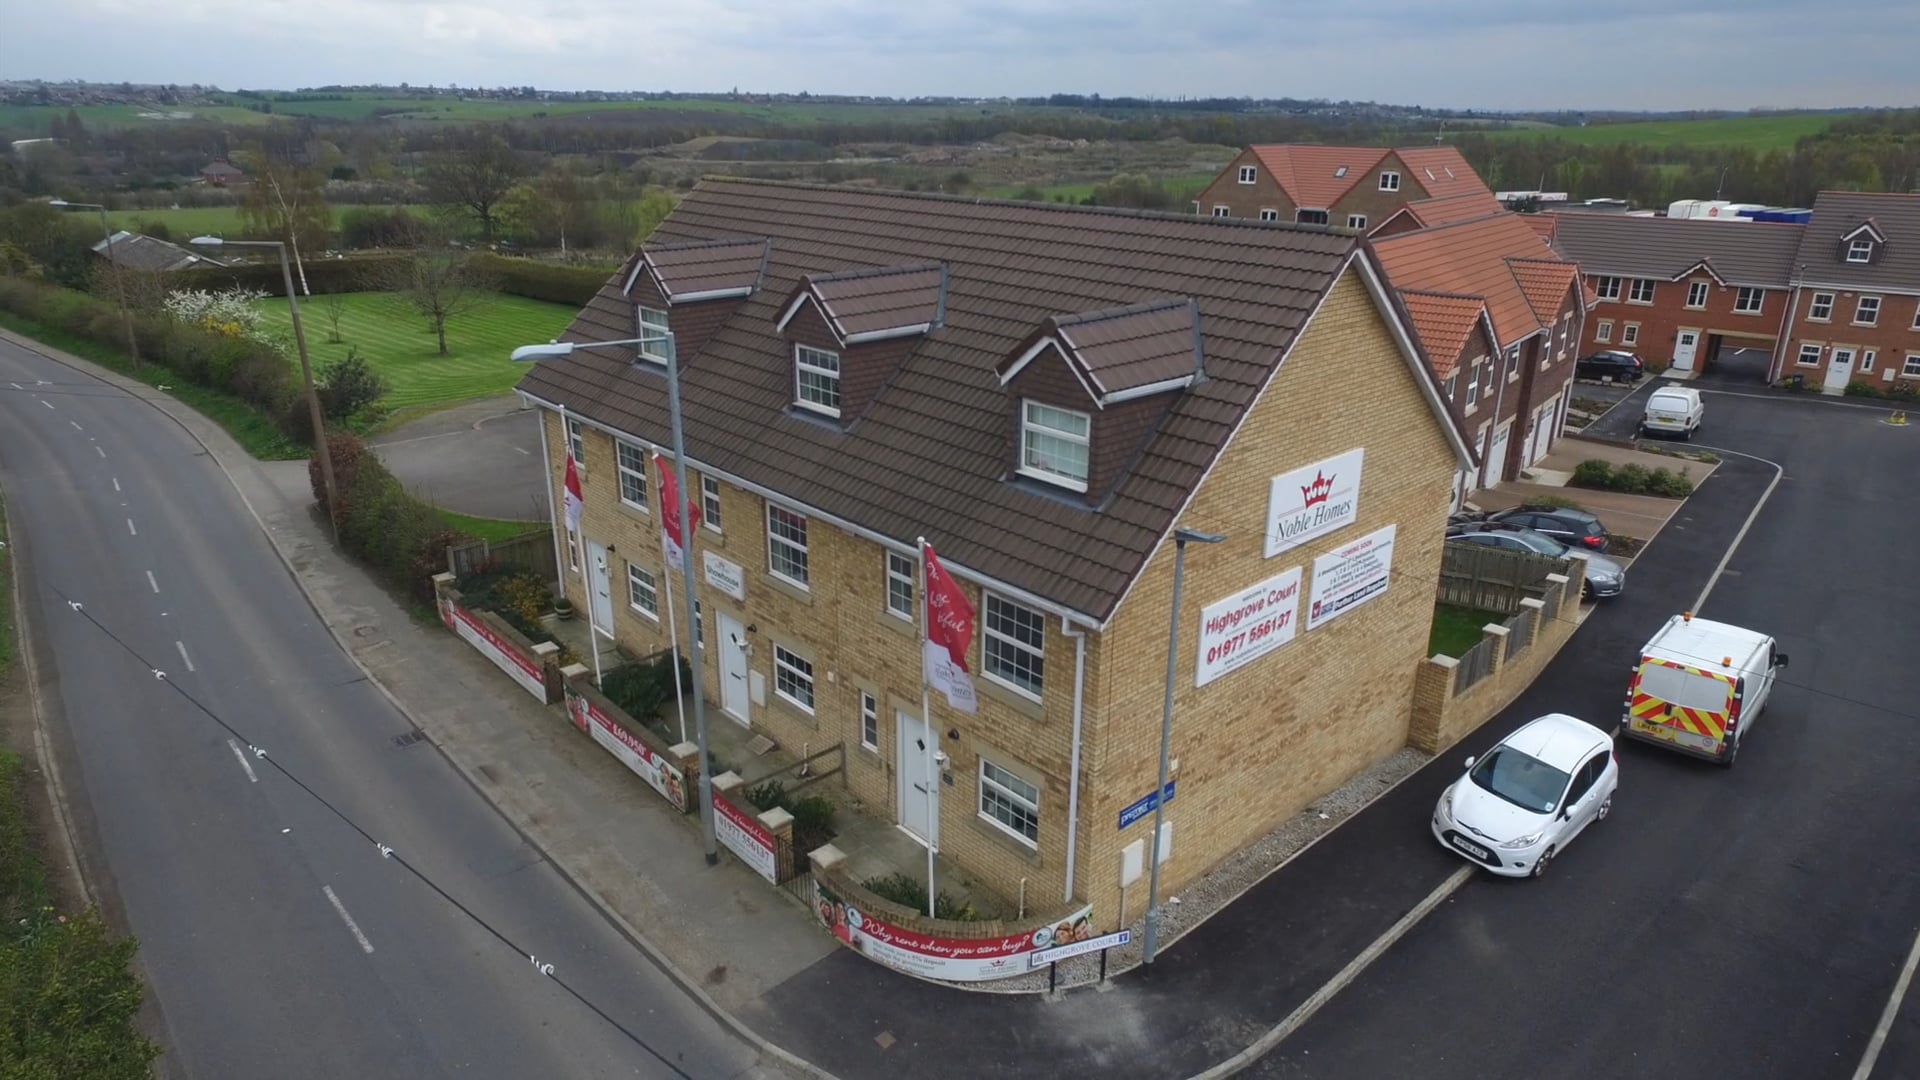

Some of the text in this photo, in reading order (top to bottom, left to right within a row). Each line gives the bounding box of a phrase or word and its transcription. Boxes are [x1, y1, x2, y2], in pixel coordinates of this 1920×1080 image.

[1276, 500, 1352, 542] Noble Homes
[1205, 598, 1265, 636] Highgrove
[1268, 581, 1297, 606] Court
[1206, 632, 1246, 665] 01977
[1249, 610, 1292, 643] 556137
[863, 918, 894, 942] Why
[895, 936, 918, 951] rent
[920, 940, 952, 953] when
[950, 947, 975, 958] you
[977, 946, 1000, 954] can
[1001, 934, 1030, 954] buy?
[1045, 935, 1117, 961] HIGHGROVE COURT
